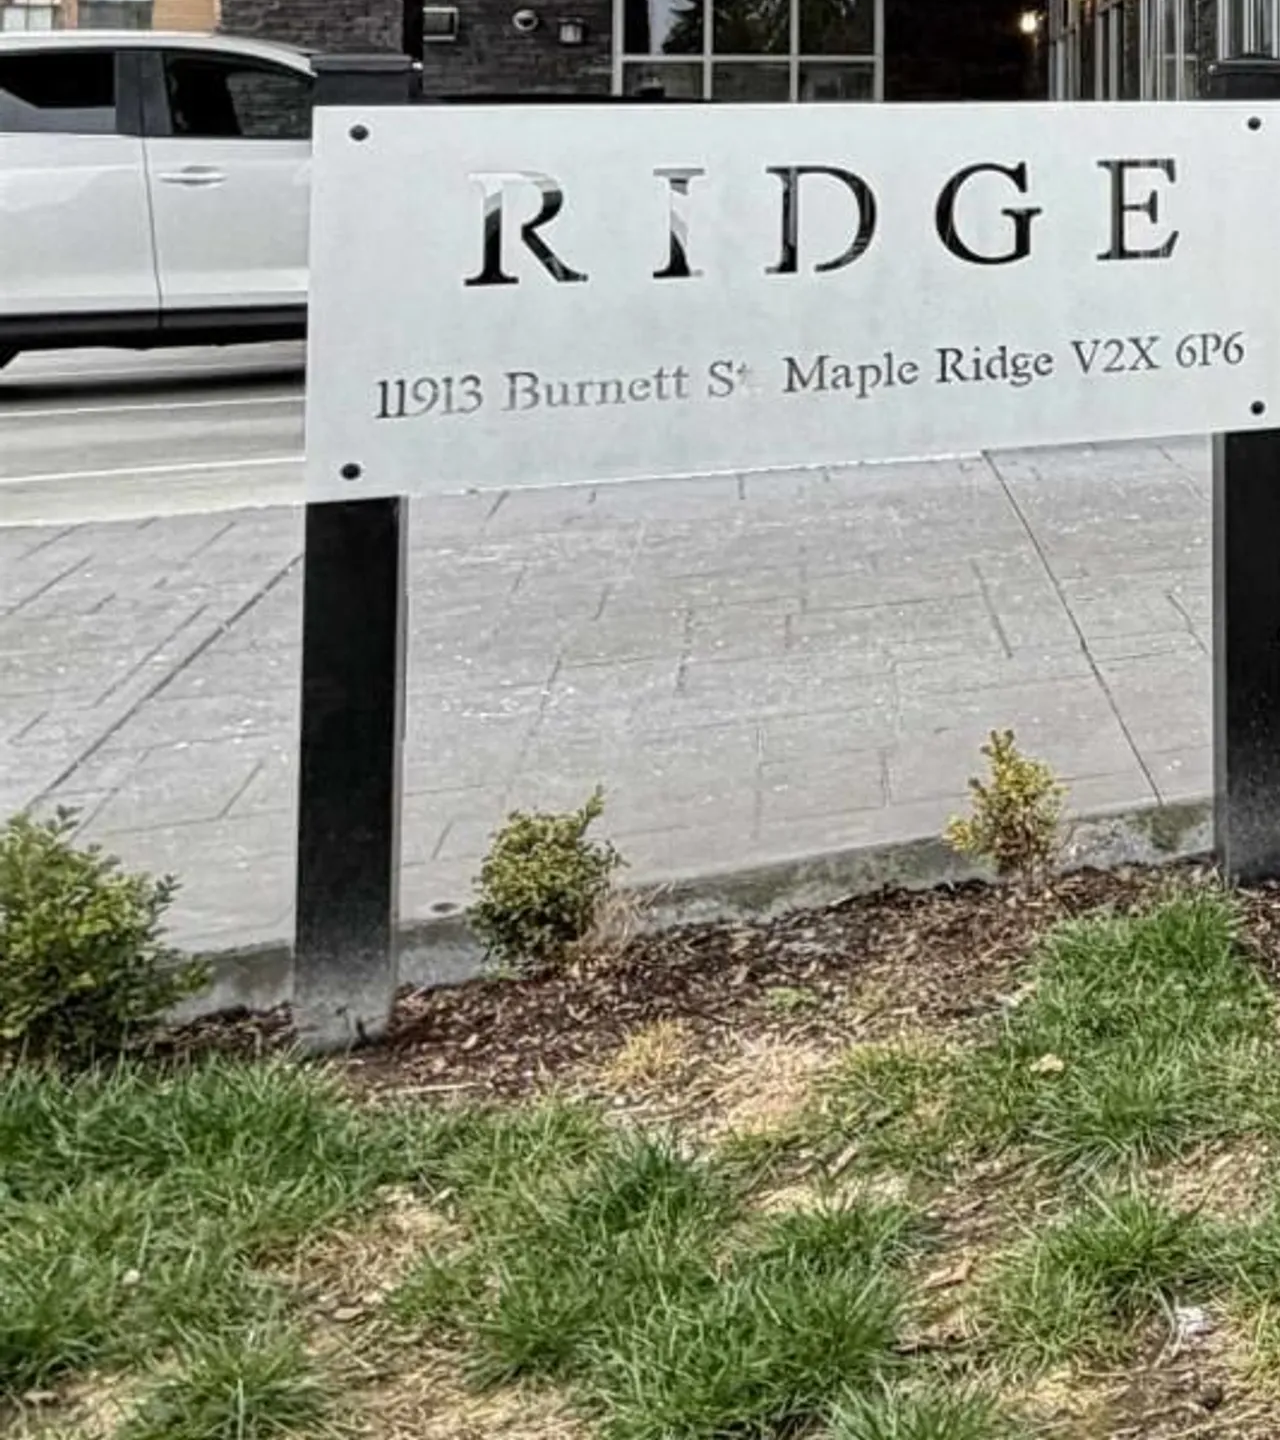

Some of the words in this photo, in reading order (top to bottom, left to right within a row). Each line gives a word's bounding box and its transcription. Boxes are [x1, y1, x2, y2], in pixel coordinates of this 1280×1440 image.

[463, 158, 1180, 287] RIDGE
[375, 373, 483, 419] 11913
[501, 365, 690, 412] Burnett
[782, 354, 919, 398] Maple
[935, 345, 1054, 386] Ridge
[1070, 335, 1161, 374] V2X
[1174, 331, 1246, 368] 6P6
